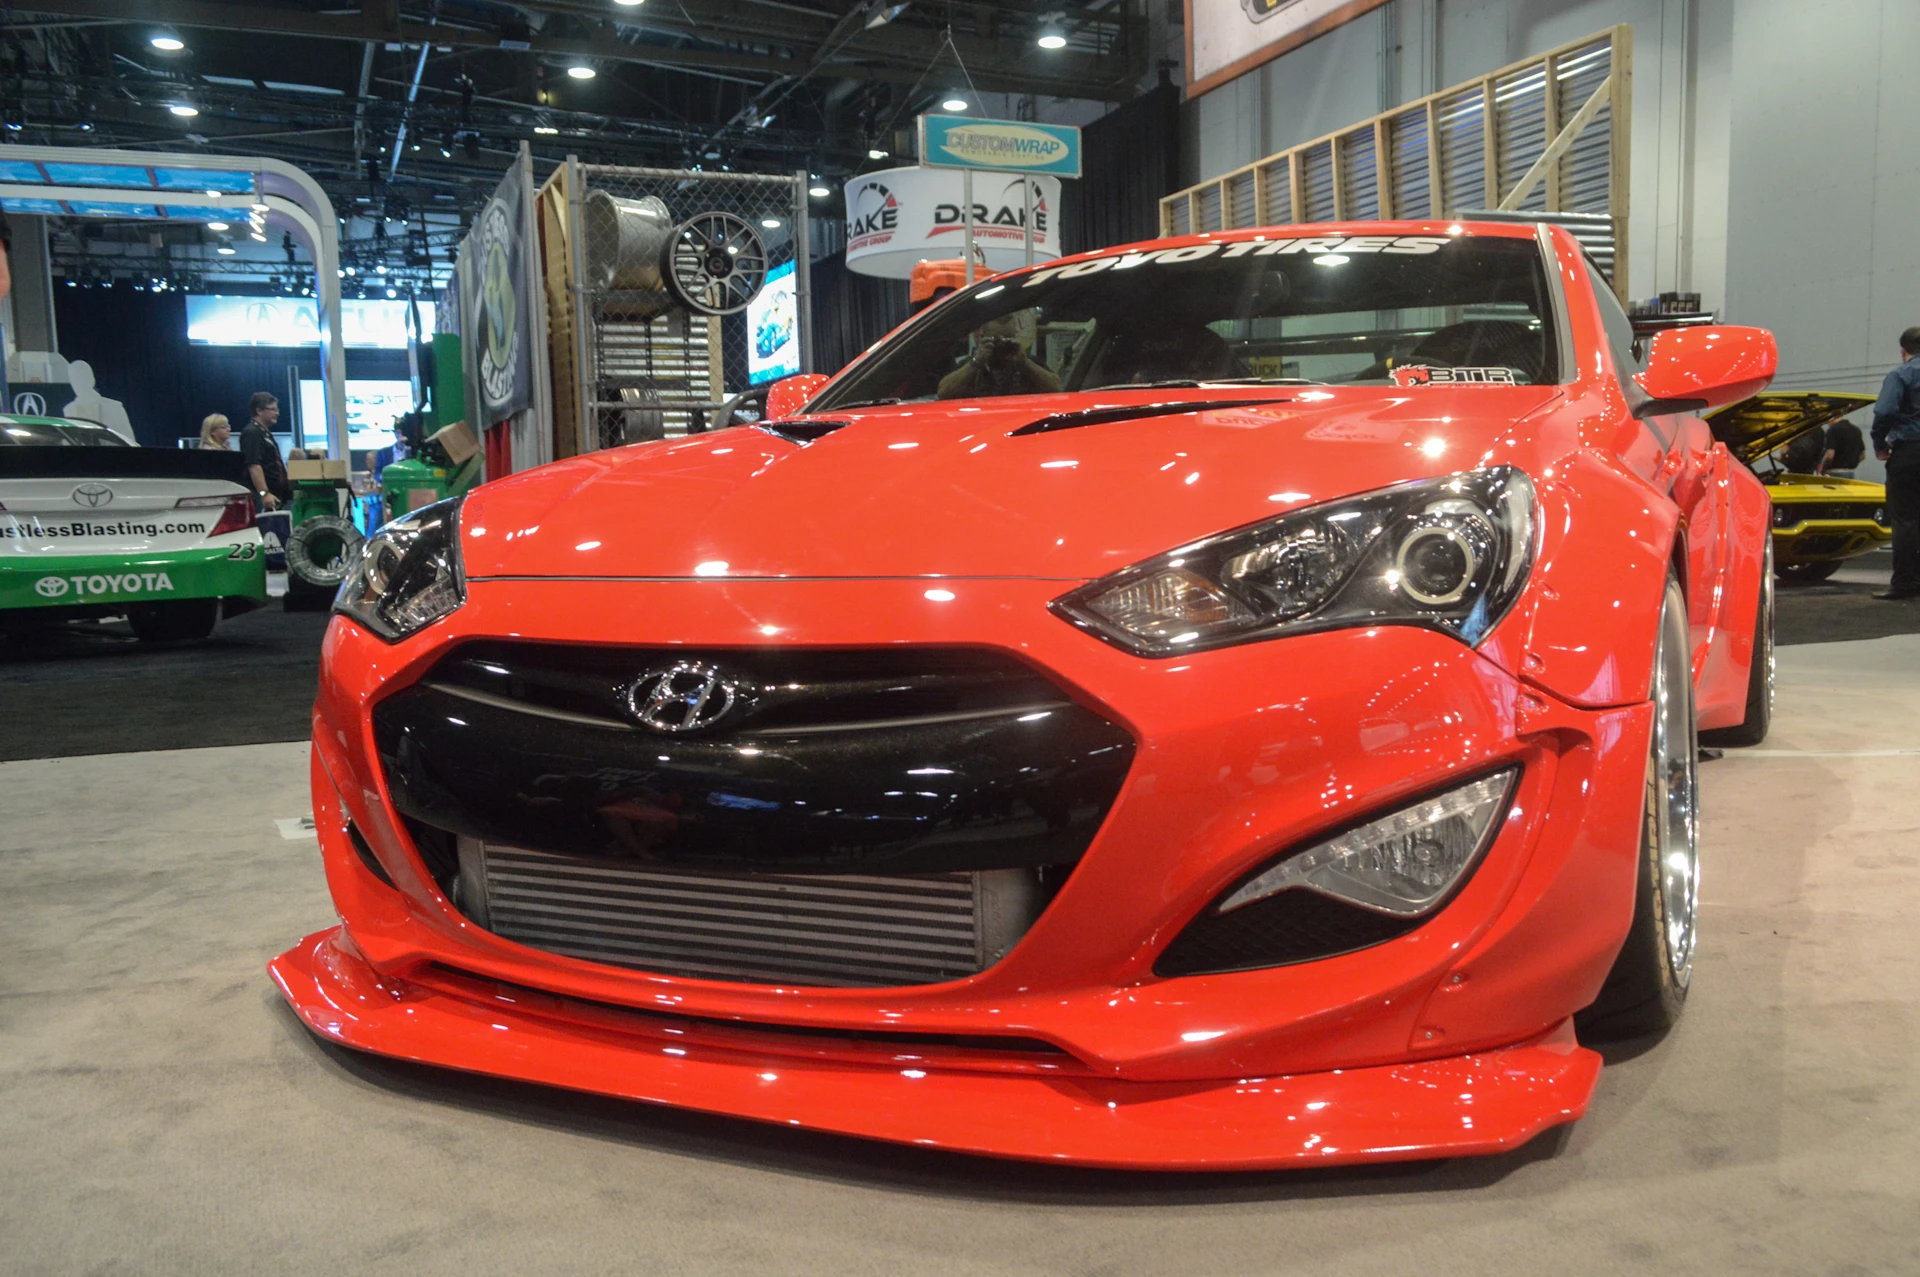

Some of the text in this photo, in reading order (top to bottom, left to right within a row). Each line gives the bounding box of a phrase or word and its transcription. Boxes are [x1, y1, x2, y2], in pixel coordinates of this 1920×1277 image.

[1022, 236, 1452, 288] TOYO TIRES
[1428, 367, 1515, 385] BTR
[228, 542, 258, 560] 23
[70, 572, 174, 595] TOYOTA
